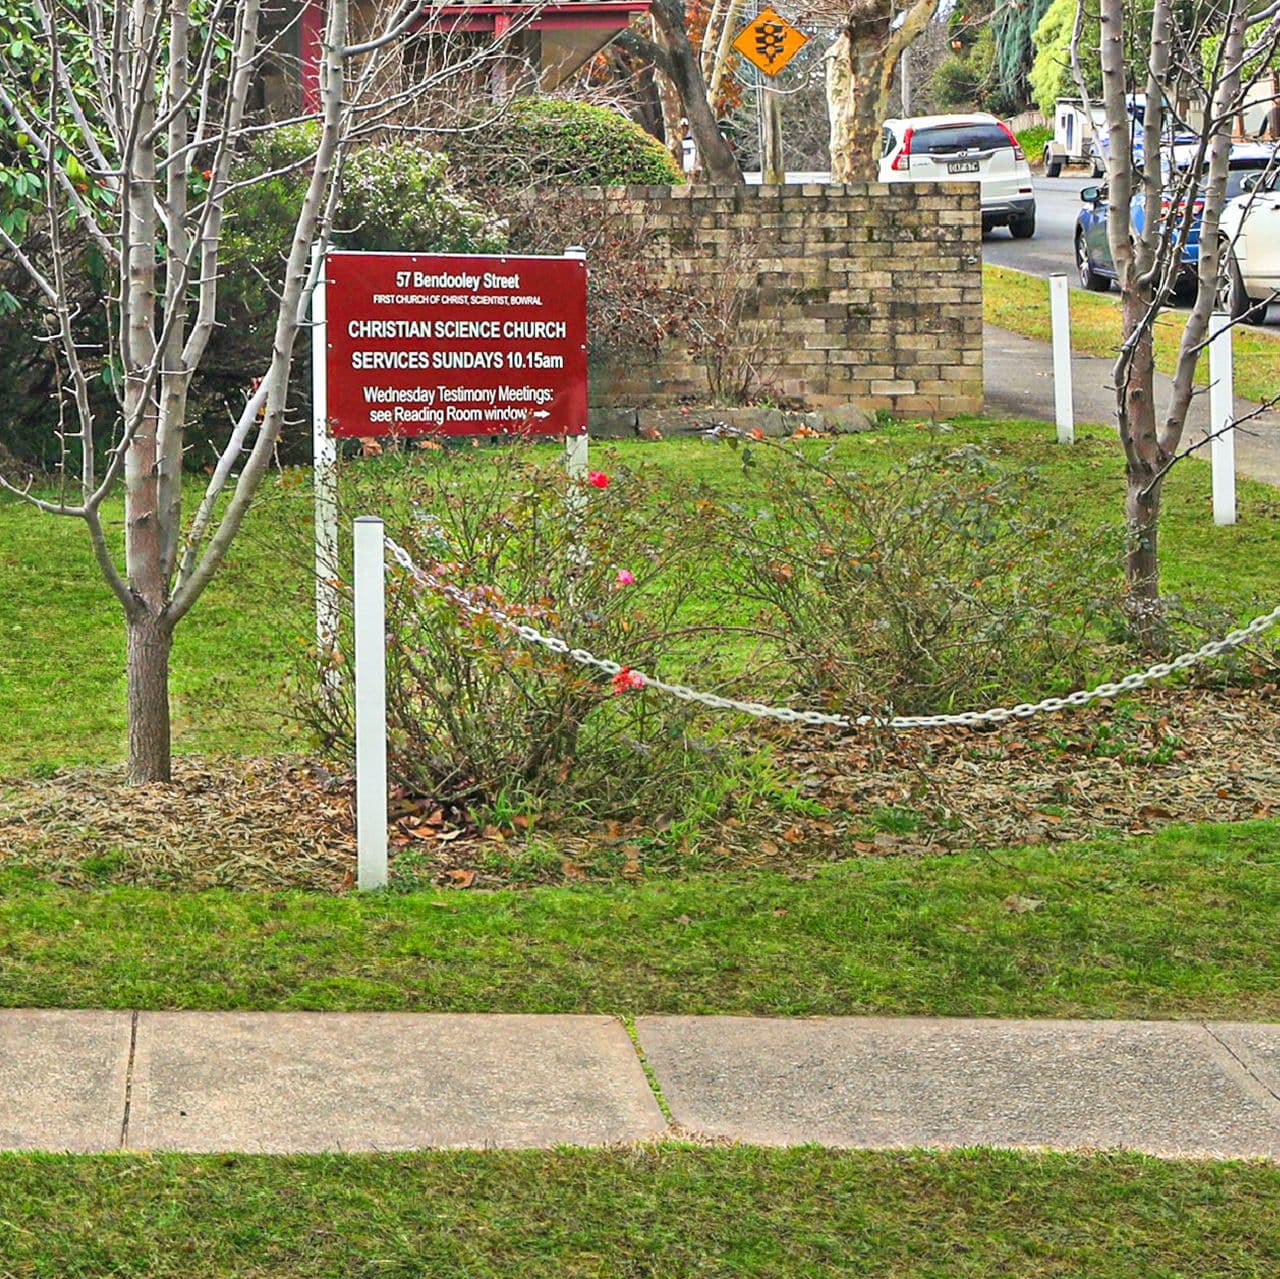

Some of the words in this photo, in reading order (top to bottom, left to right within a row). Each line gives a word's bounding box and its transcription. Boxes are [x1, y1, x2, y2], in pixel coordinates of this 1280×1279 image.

[396, 271, 411, 288] 57
[414, 272, 480, 292] Bendooley
[483, 273, 520, 289] Street
[373, 294, 395, 304] FIRST
[396, 294, 429, 304] CHURCH
[430, 295, 440, 304] OF
[511, 297, 543, 306] BOWRAL
[348, 321, 431, 337] CHRISTIAN
[434, 321, 500, 338] SCIENCE
[503, 322, 566, 338] CHURCH
[351, 352, 429, 368] SERVICES
[432, 352, 504, 368] SUNDAYS
[506, 353, 563, 368] 10.15am
[363, 386, 435, 405] Wednesday
[437, 386, 496, 404] Testimony
[498, 386, 554, 404] Meetings:
[370, 410, 392, 421] see
[394, 406, 444, 424] Reading
[446, 407, 482, 420] Room
[484, 407, 528, 419] window
